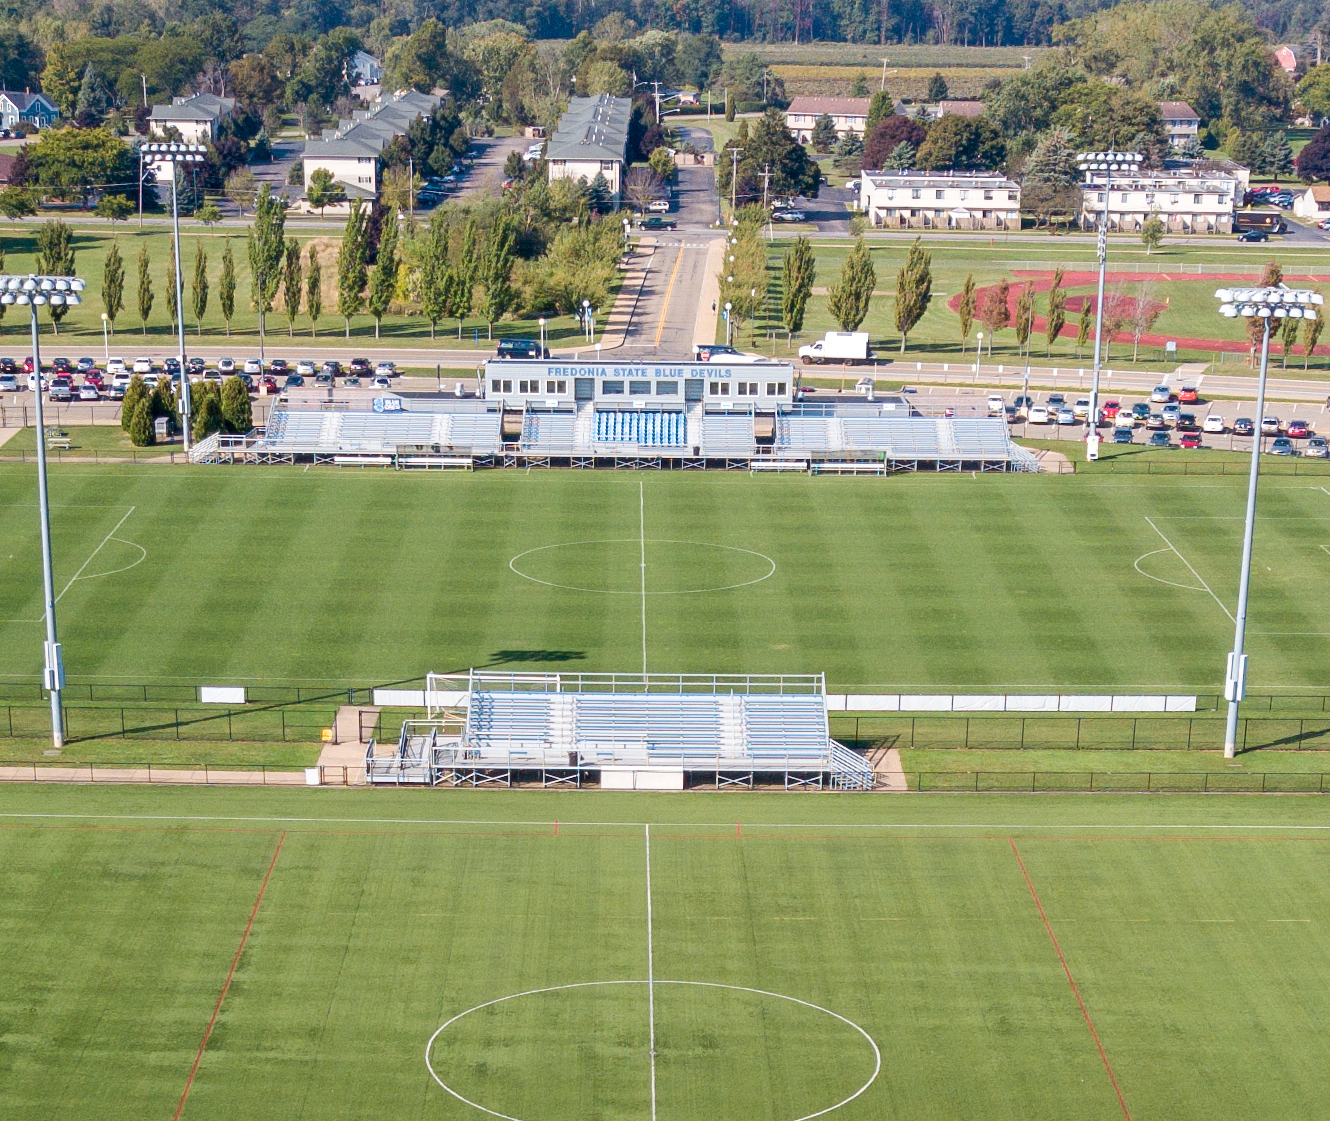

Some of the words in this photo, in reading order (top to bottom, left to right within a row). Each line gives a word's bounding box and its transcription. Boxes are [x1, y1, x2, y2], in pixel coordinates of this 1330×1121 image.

[547, 367, 607, 377] FREDONIA
[613, 368, 648, 377] STATE
[655, 368, 684, 378] BLUE
[691, 368, 732, 378] DEVILS
